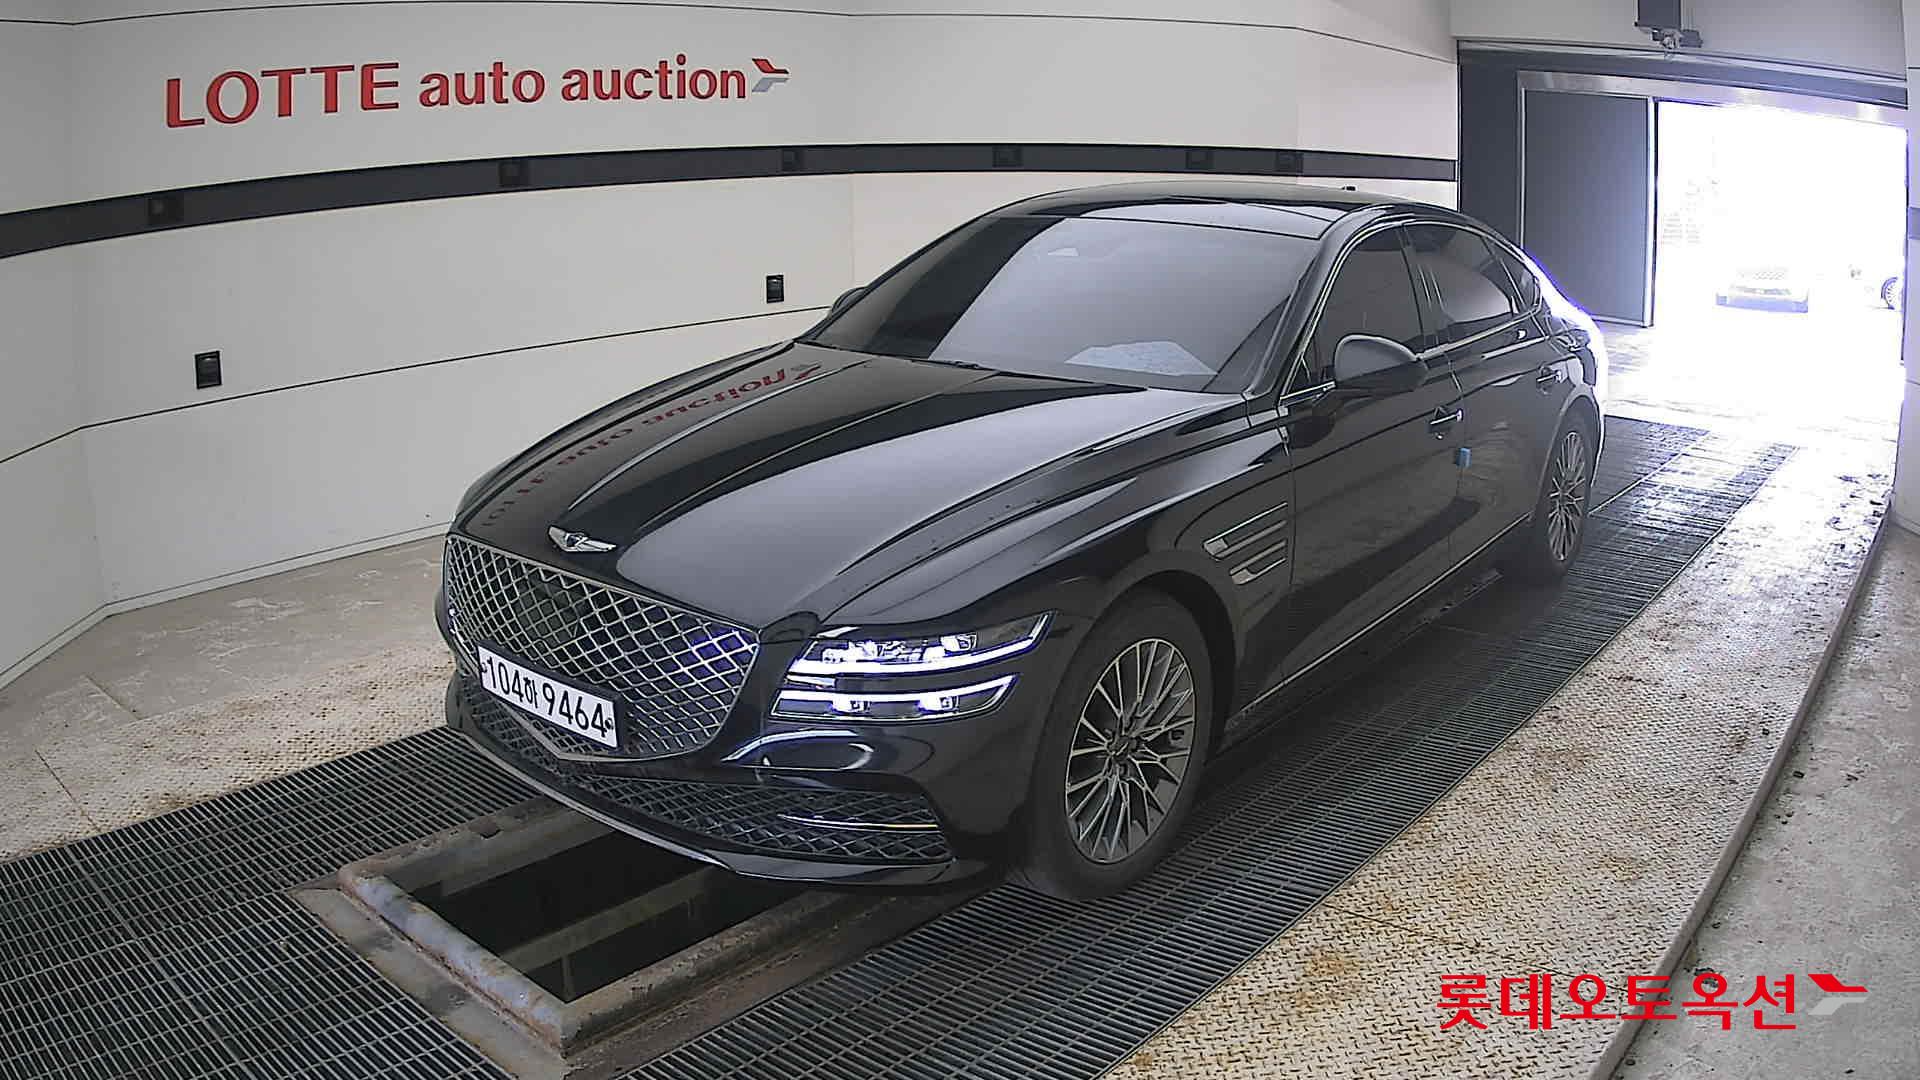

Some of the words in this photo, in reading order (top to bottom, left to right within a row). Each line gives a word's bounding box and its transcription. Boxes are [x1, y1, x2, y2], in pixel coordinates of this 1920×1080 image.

[166, 62, 399, 128] LOTTE
[419, 61, 545, 107] auto
[561, 53, 746, 101] auction
[487, 656, 538, 709] 104하
[542, 682, 608, 737] 9464
